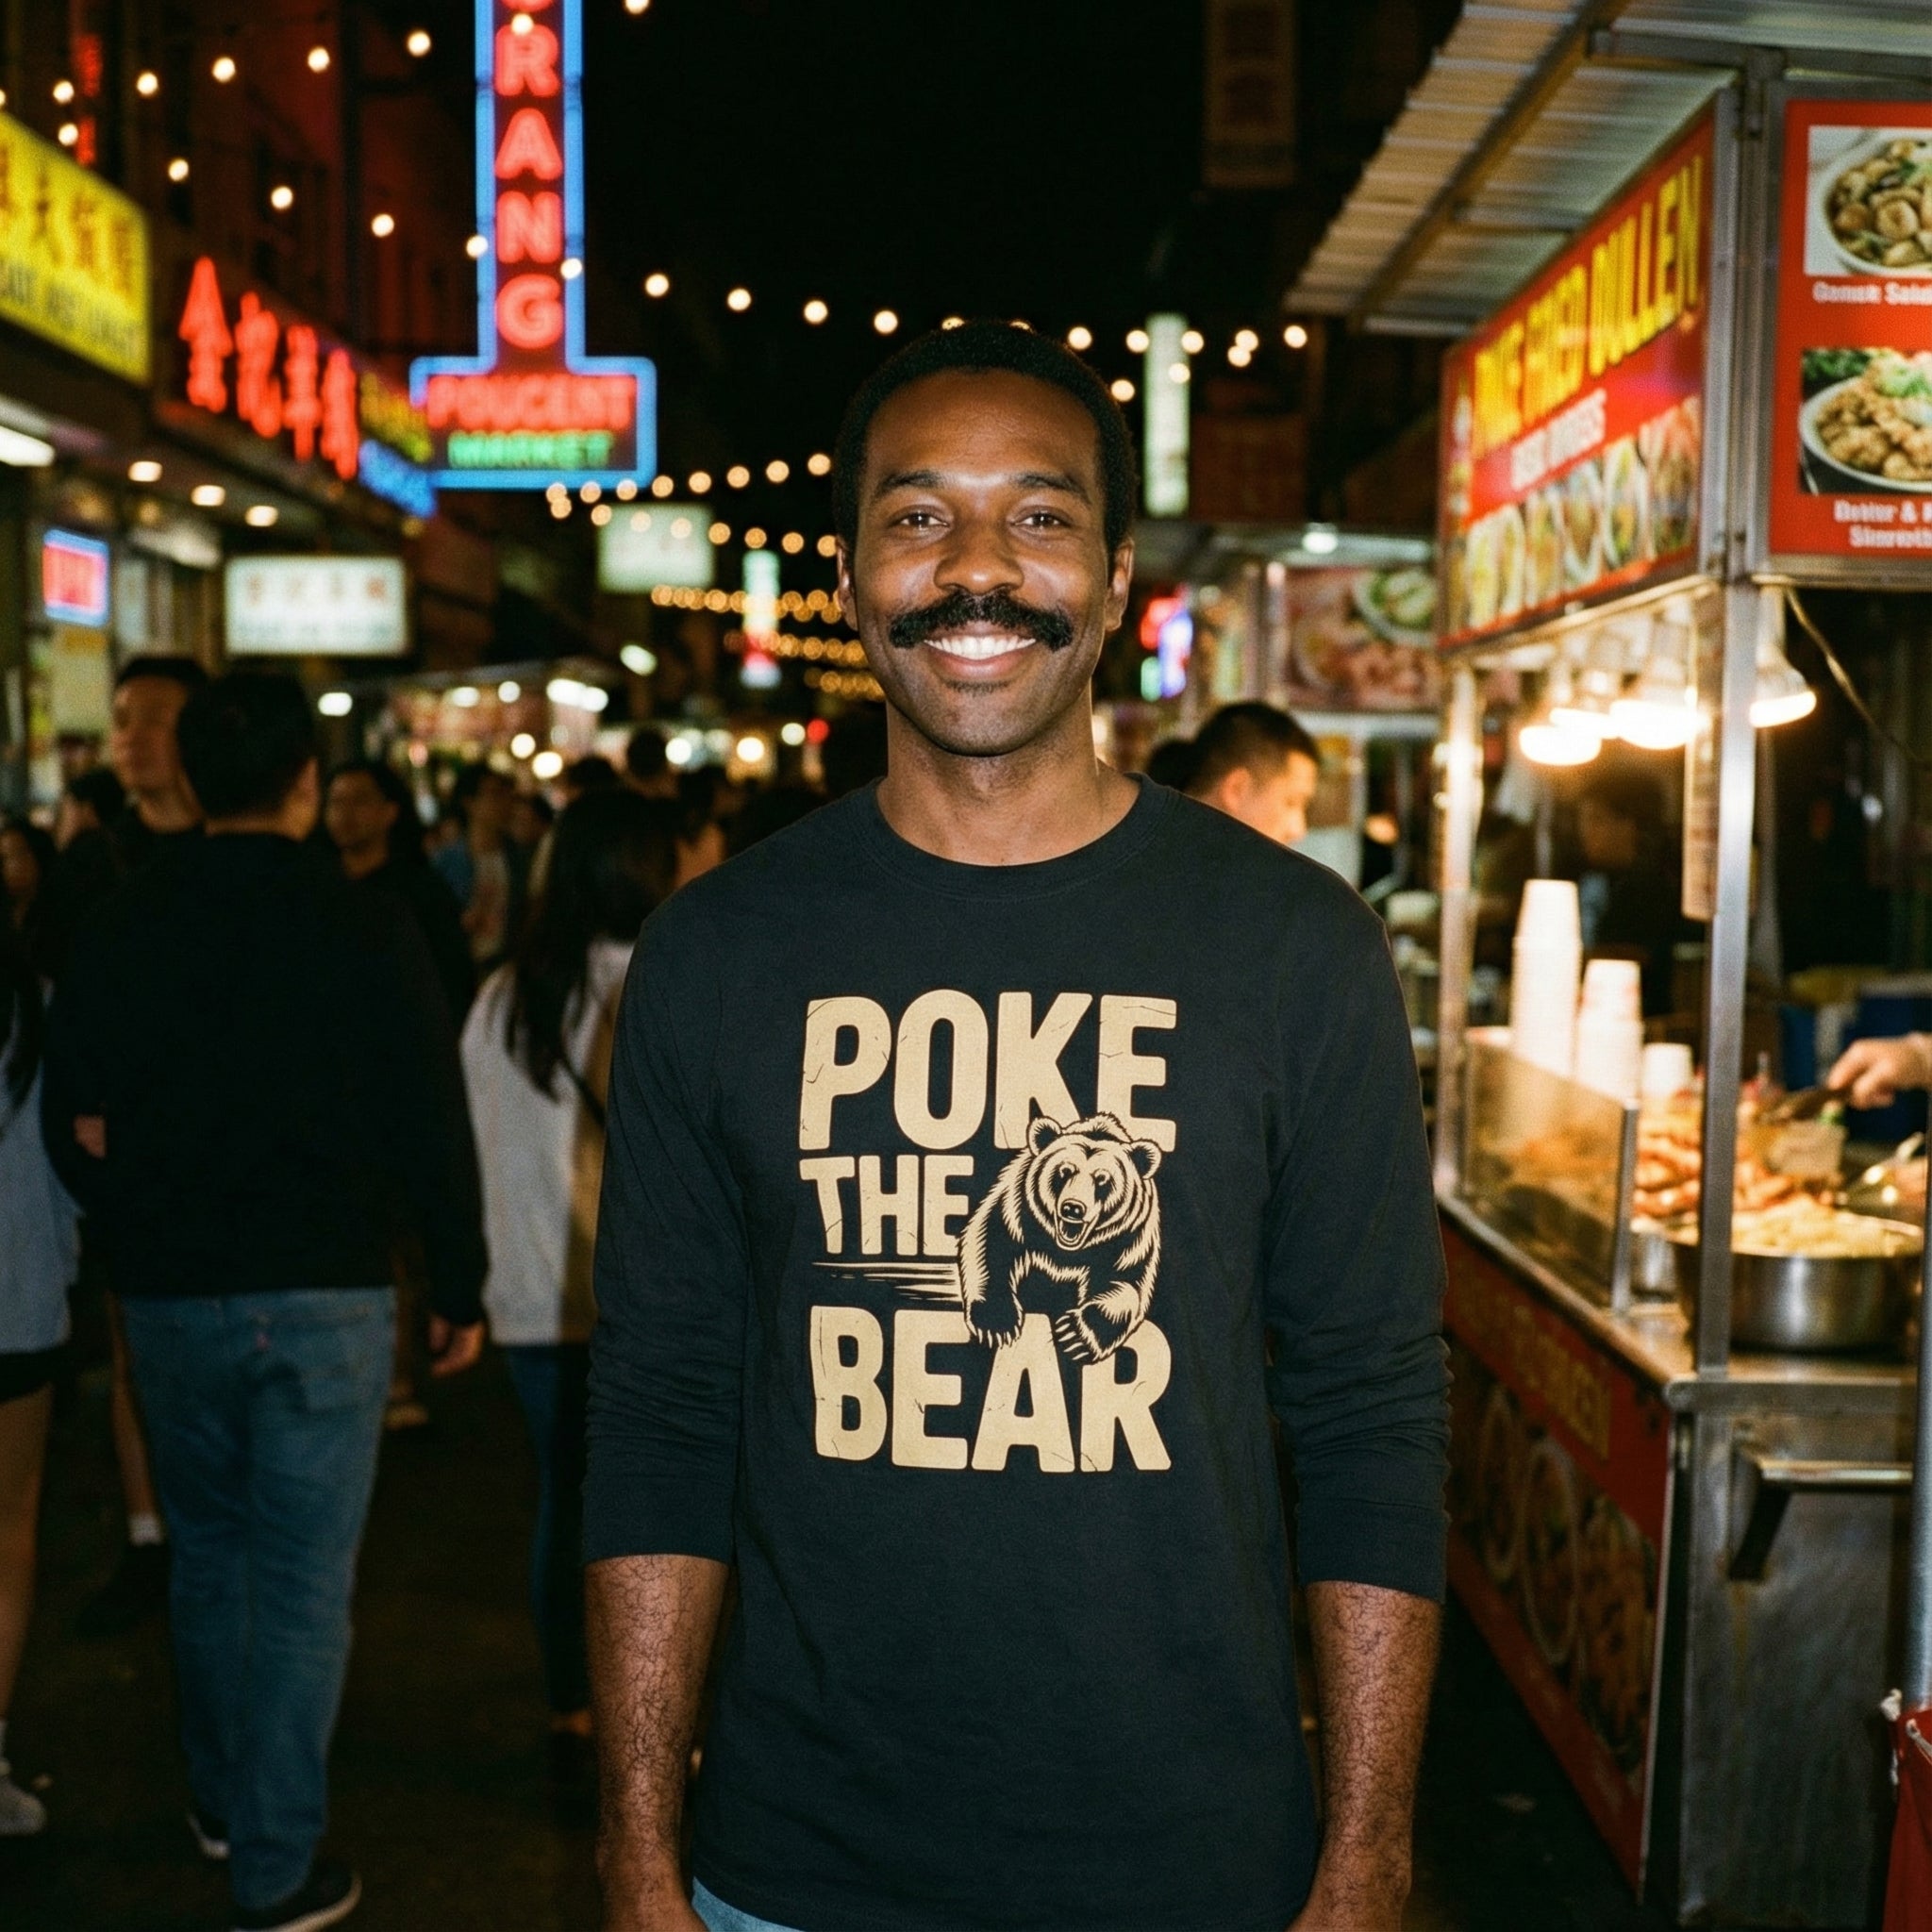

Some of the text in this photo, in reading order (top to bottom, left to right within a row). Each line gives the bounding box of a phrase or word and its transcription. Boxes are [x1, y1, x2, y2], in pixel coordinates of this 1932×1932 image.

[493, 0, 564, 349] RANG
[1900, 499, 1918, 524] &
[798, 989, 1178, 1153] POKE
[799, 1154, 974, 1257] THE
[809, 1305, 1172, 1474] BEAR
